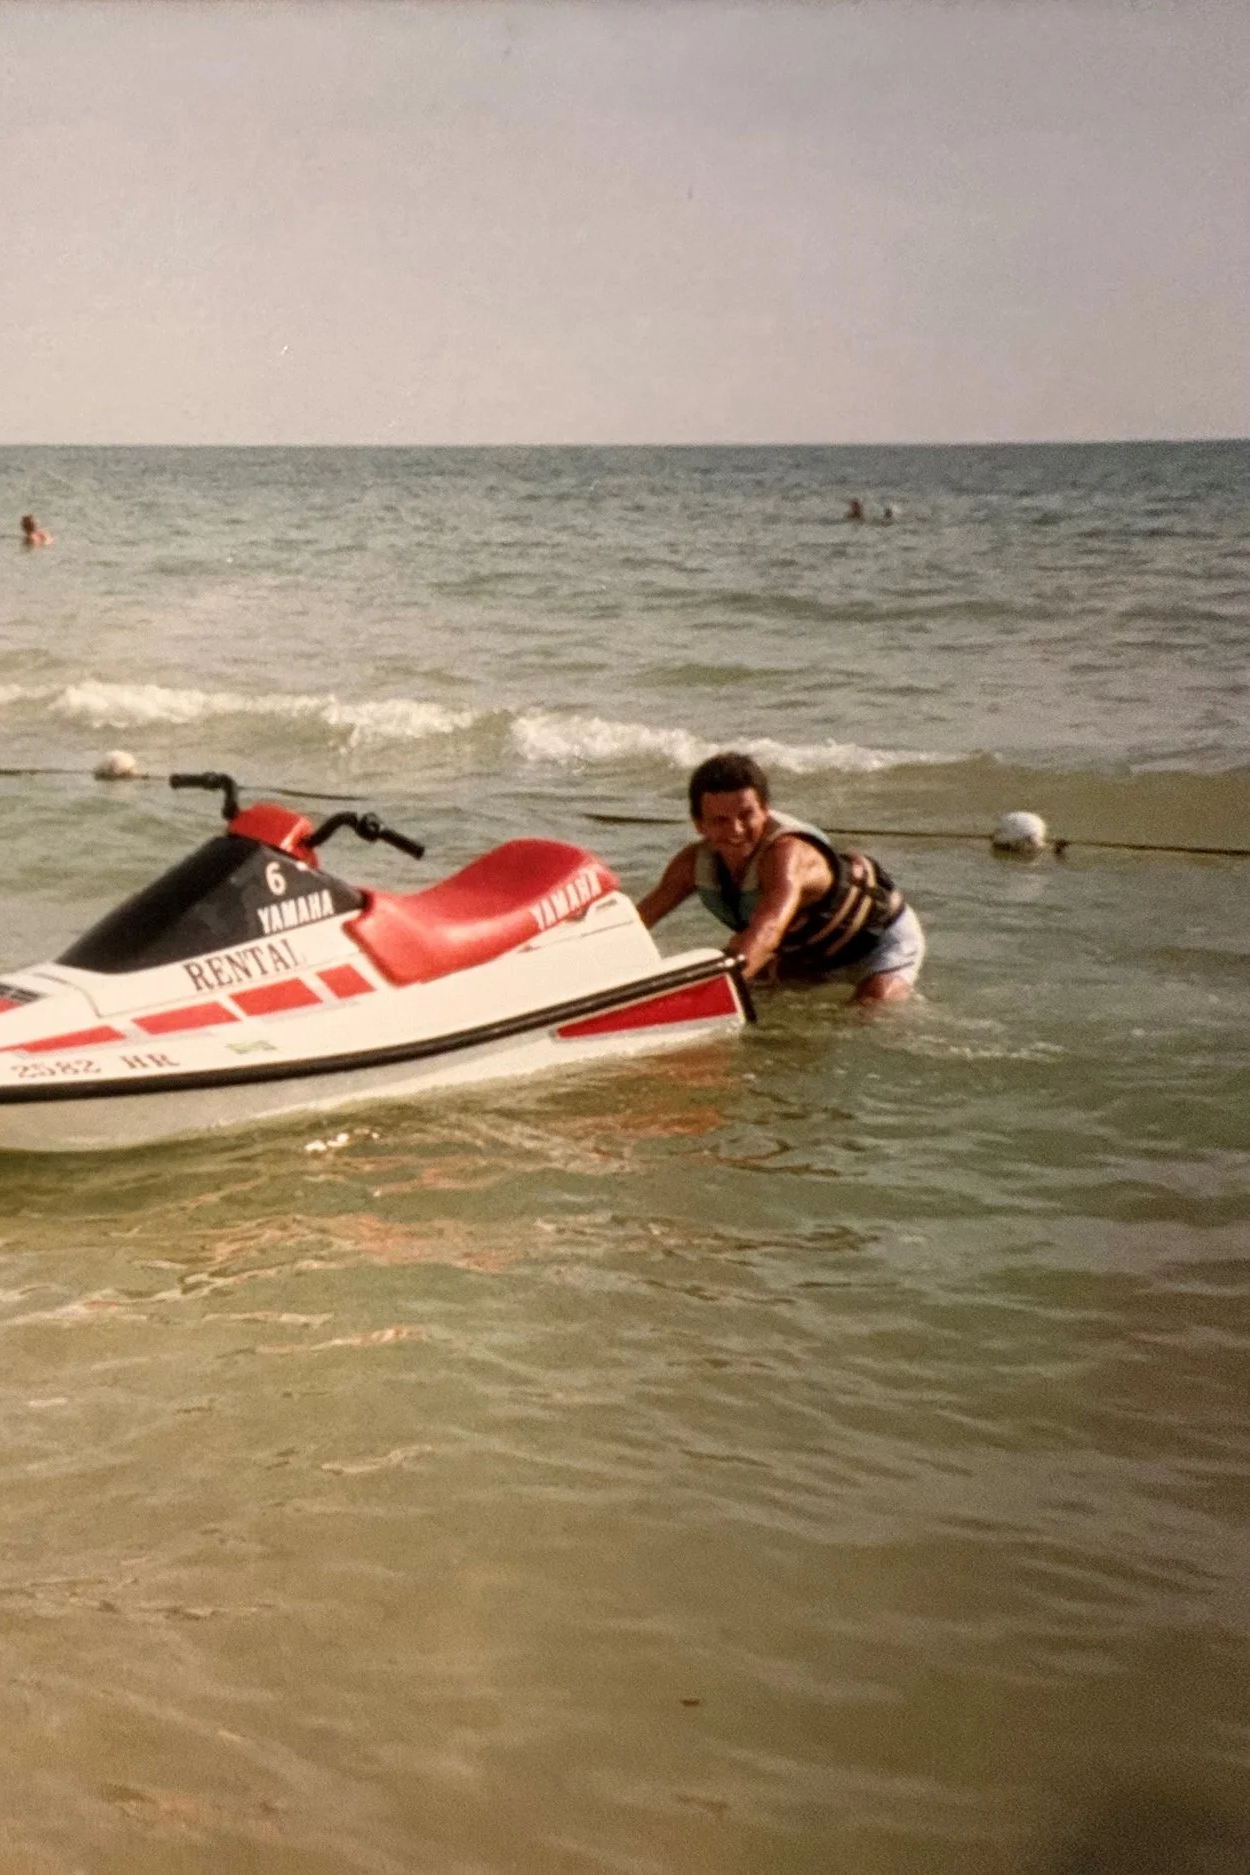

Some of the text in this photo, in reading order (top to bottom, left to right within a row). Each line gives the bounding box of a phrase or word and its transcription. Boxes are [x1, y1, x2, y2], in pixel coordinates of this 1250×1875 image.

[265, 861, 287, 896] 6
[257, 888, 334, 935] YAMAHA
[183, 938, 307, 992] RENTAL
